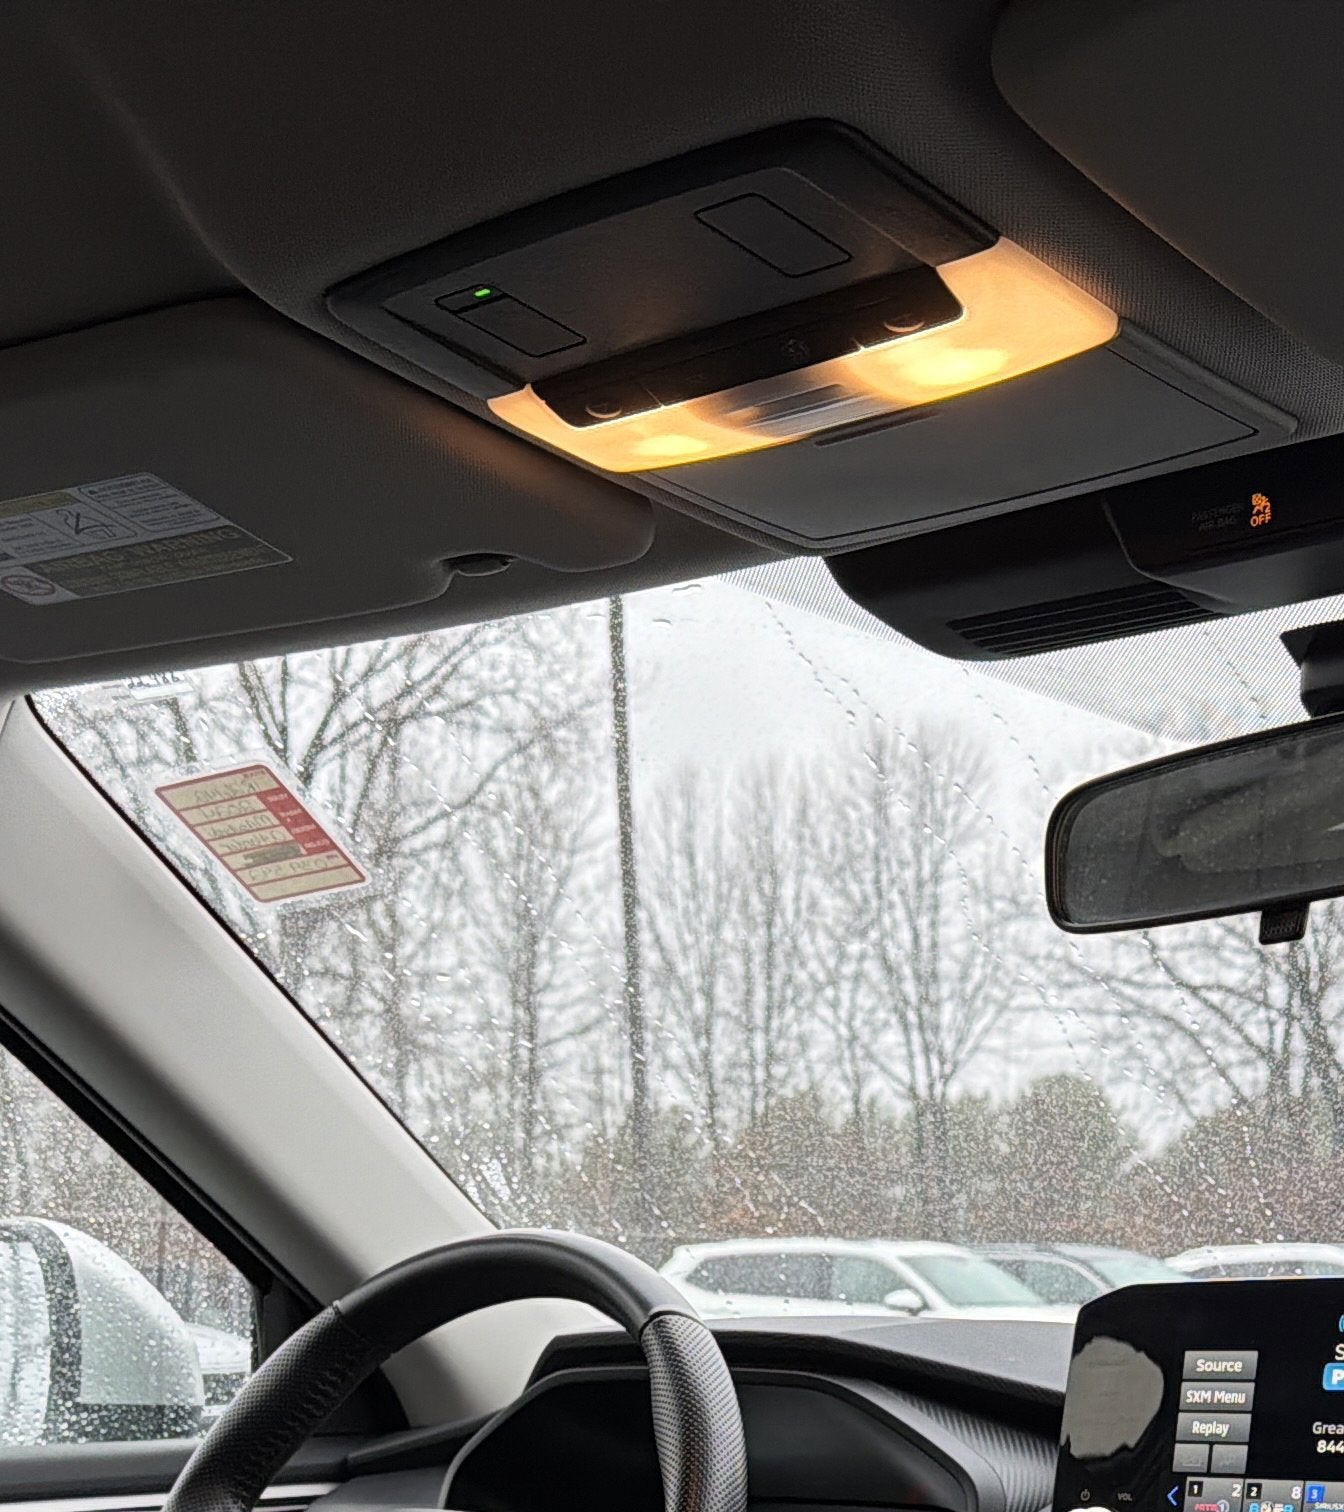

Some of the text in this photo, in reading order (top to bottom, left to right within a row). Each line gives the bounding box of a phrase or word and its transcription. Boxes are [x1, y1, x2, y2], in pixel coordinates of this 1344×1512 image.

[1250, 513, 1271, 527] OFF
[1196, 1358, 1243, 1373] Source
[1186, 1390, 1246, 1404] SXM Menu
[1192, 1421, 1230, 1437] Replay
[1232, 1484, 1241, 1497] 2
[1291, 1486, 1301, 1499] 8
